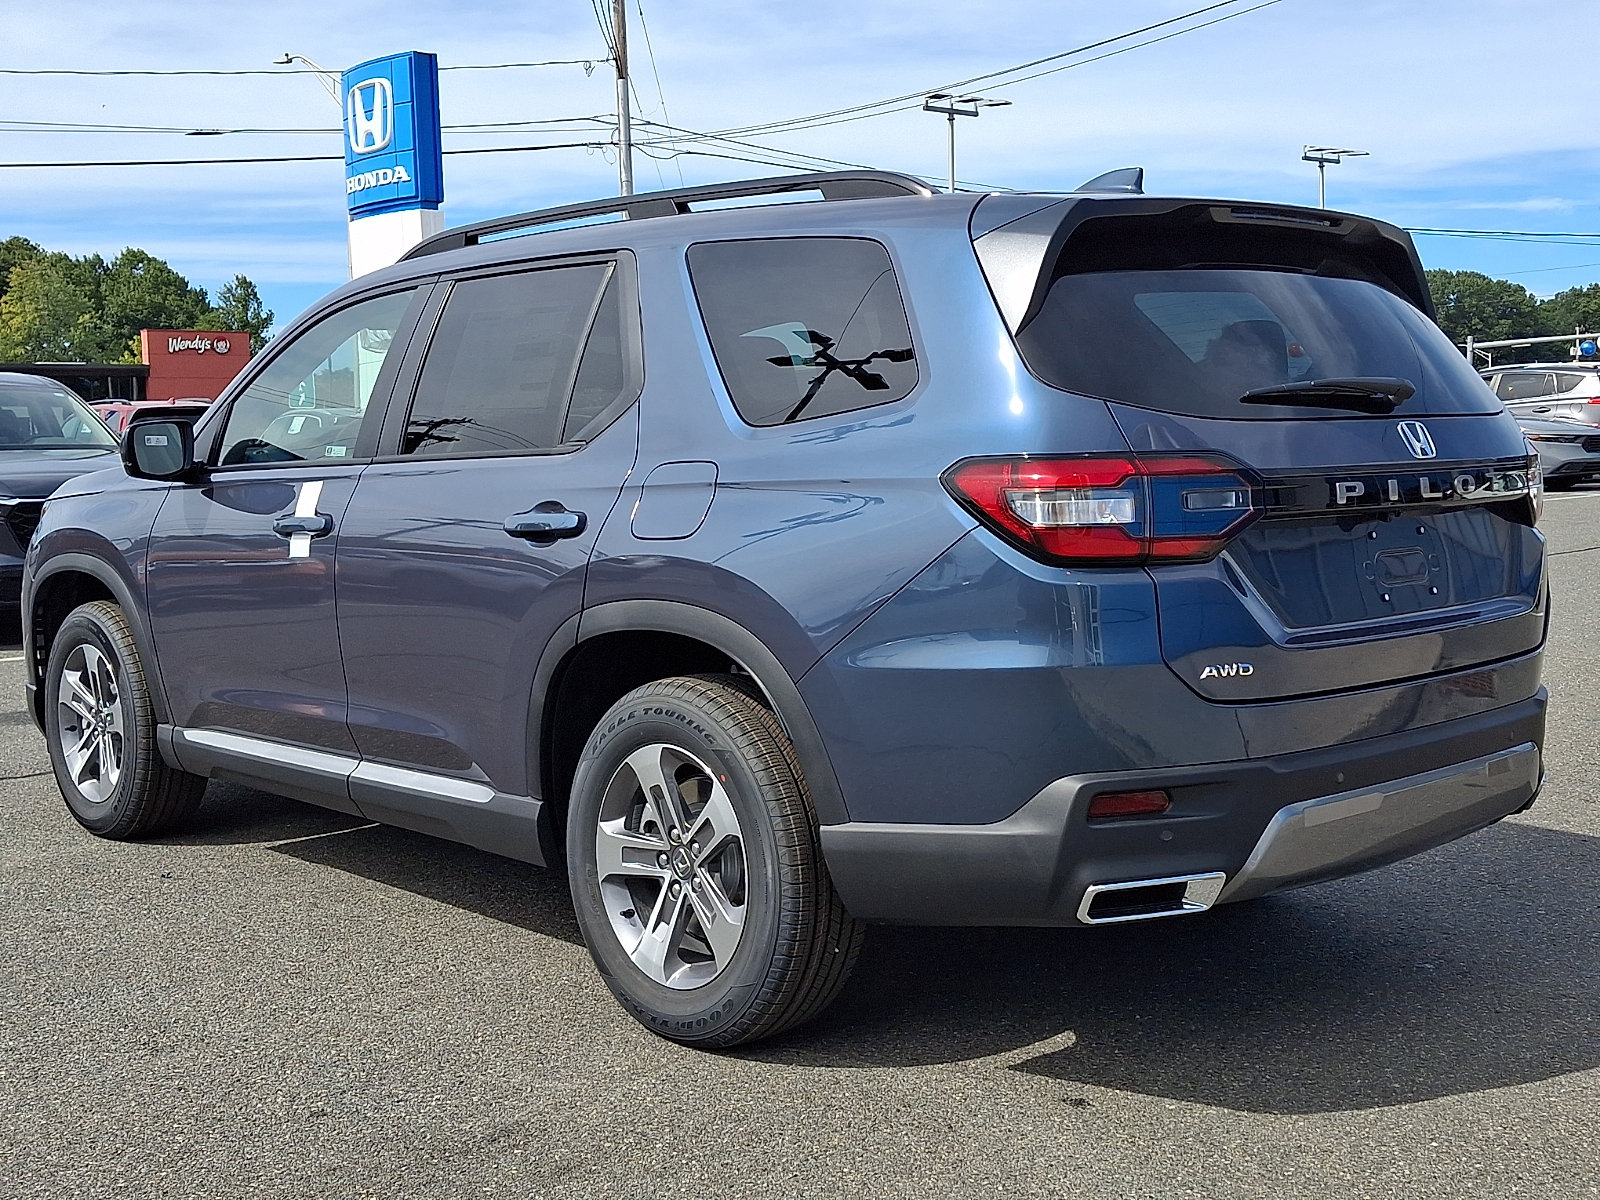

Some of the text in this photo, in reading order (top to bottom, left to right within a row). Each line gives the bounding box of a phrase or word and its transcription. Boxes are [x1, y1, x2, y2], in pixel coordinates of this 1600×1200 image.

[346, 166, 411, 195] HONDA
[168, 335, 211, 354] Wendy's
[1336, 471, 1503, 505] PILOT
[1200, 662, 1254, 680] AWD
[592, 707, 717, 755] EAGLE TOURING
